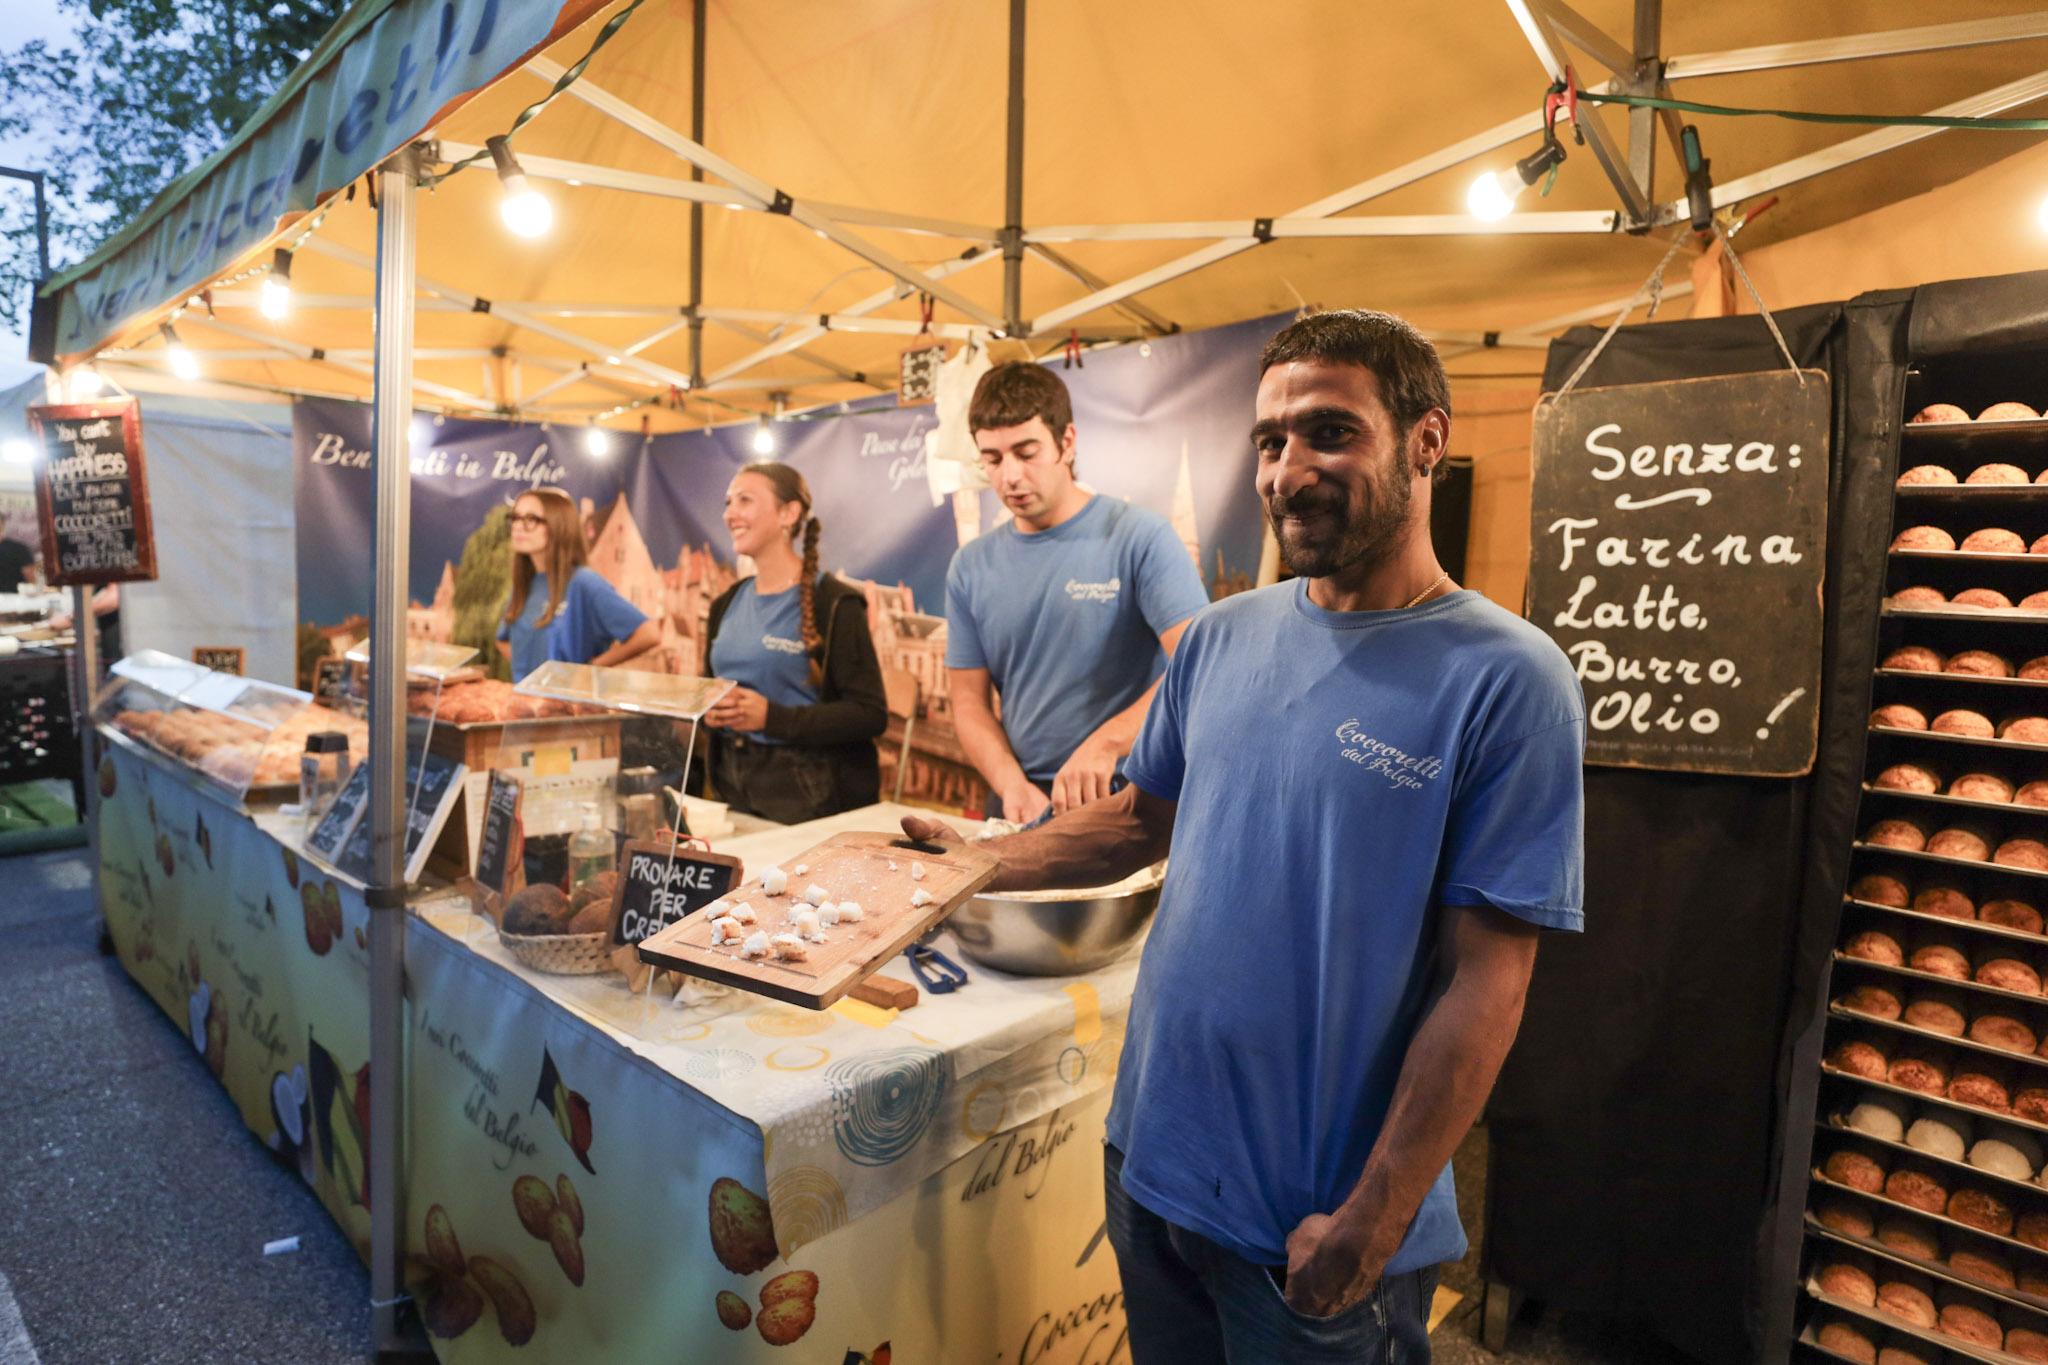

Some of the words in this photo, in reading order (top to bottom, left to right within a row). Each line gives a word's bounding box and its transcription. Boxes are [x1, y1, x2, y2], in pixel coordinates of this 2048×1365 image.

[455, 452, 485, 481] in
[490, 443, 569, 491] Belgio
[1585, 423, 1802, 481] Senza:
[1554, 574, 1708, 632] Latte,
[1568, 640, 1742, 688] Burro,
[1590, 691, 1720, 734] Olio
[1335, 718, 1443, 780] Coccoretti
[1341, 747, 1374, 765] dal
[1365, 756, 1424, 790] Belgio
[630, 855, 716, 889] PROVARE
[649, 887, 687, 917] PER
[483, 1112, 538, 1172] Belgio
[1013, 1106, 1075, 1200] Belgio
